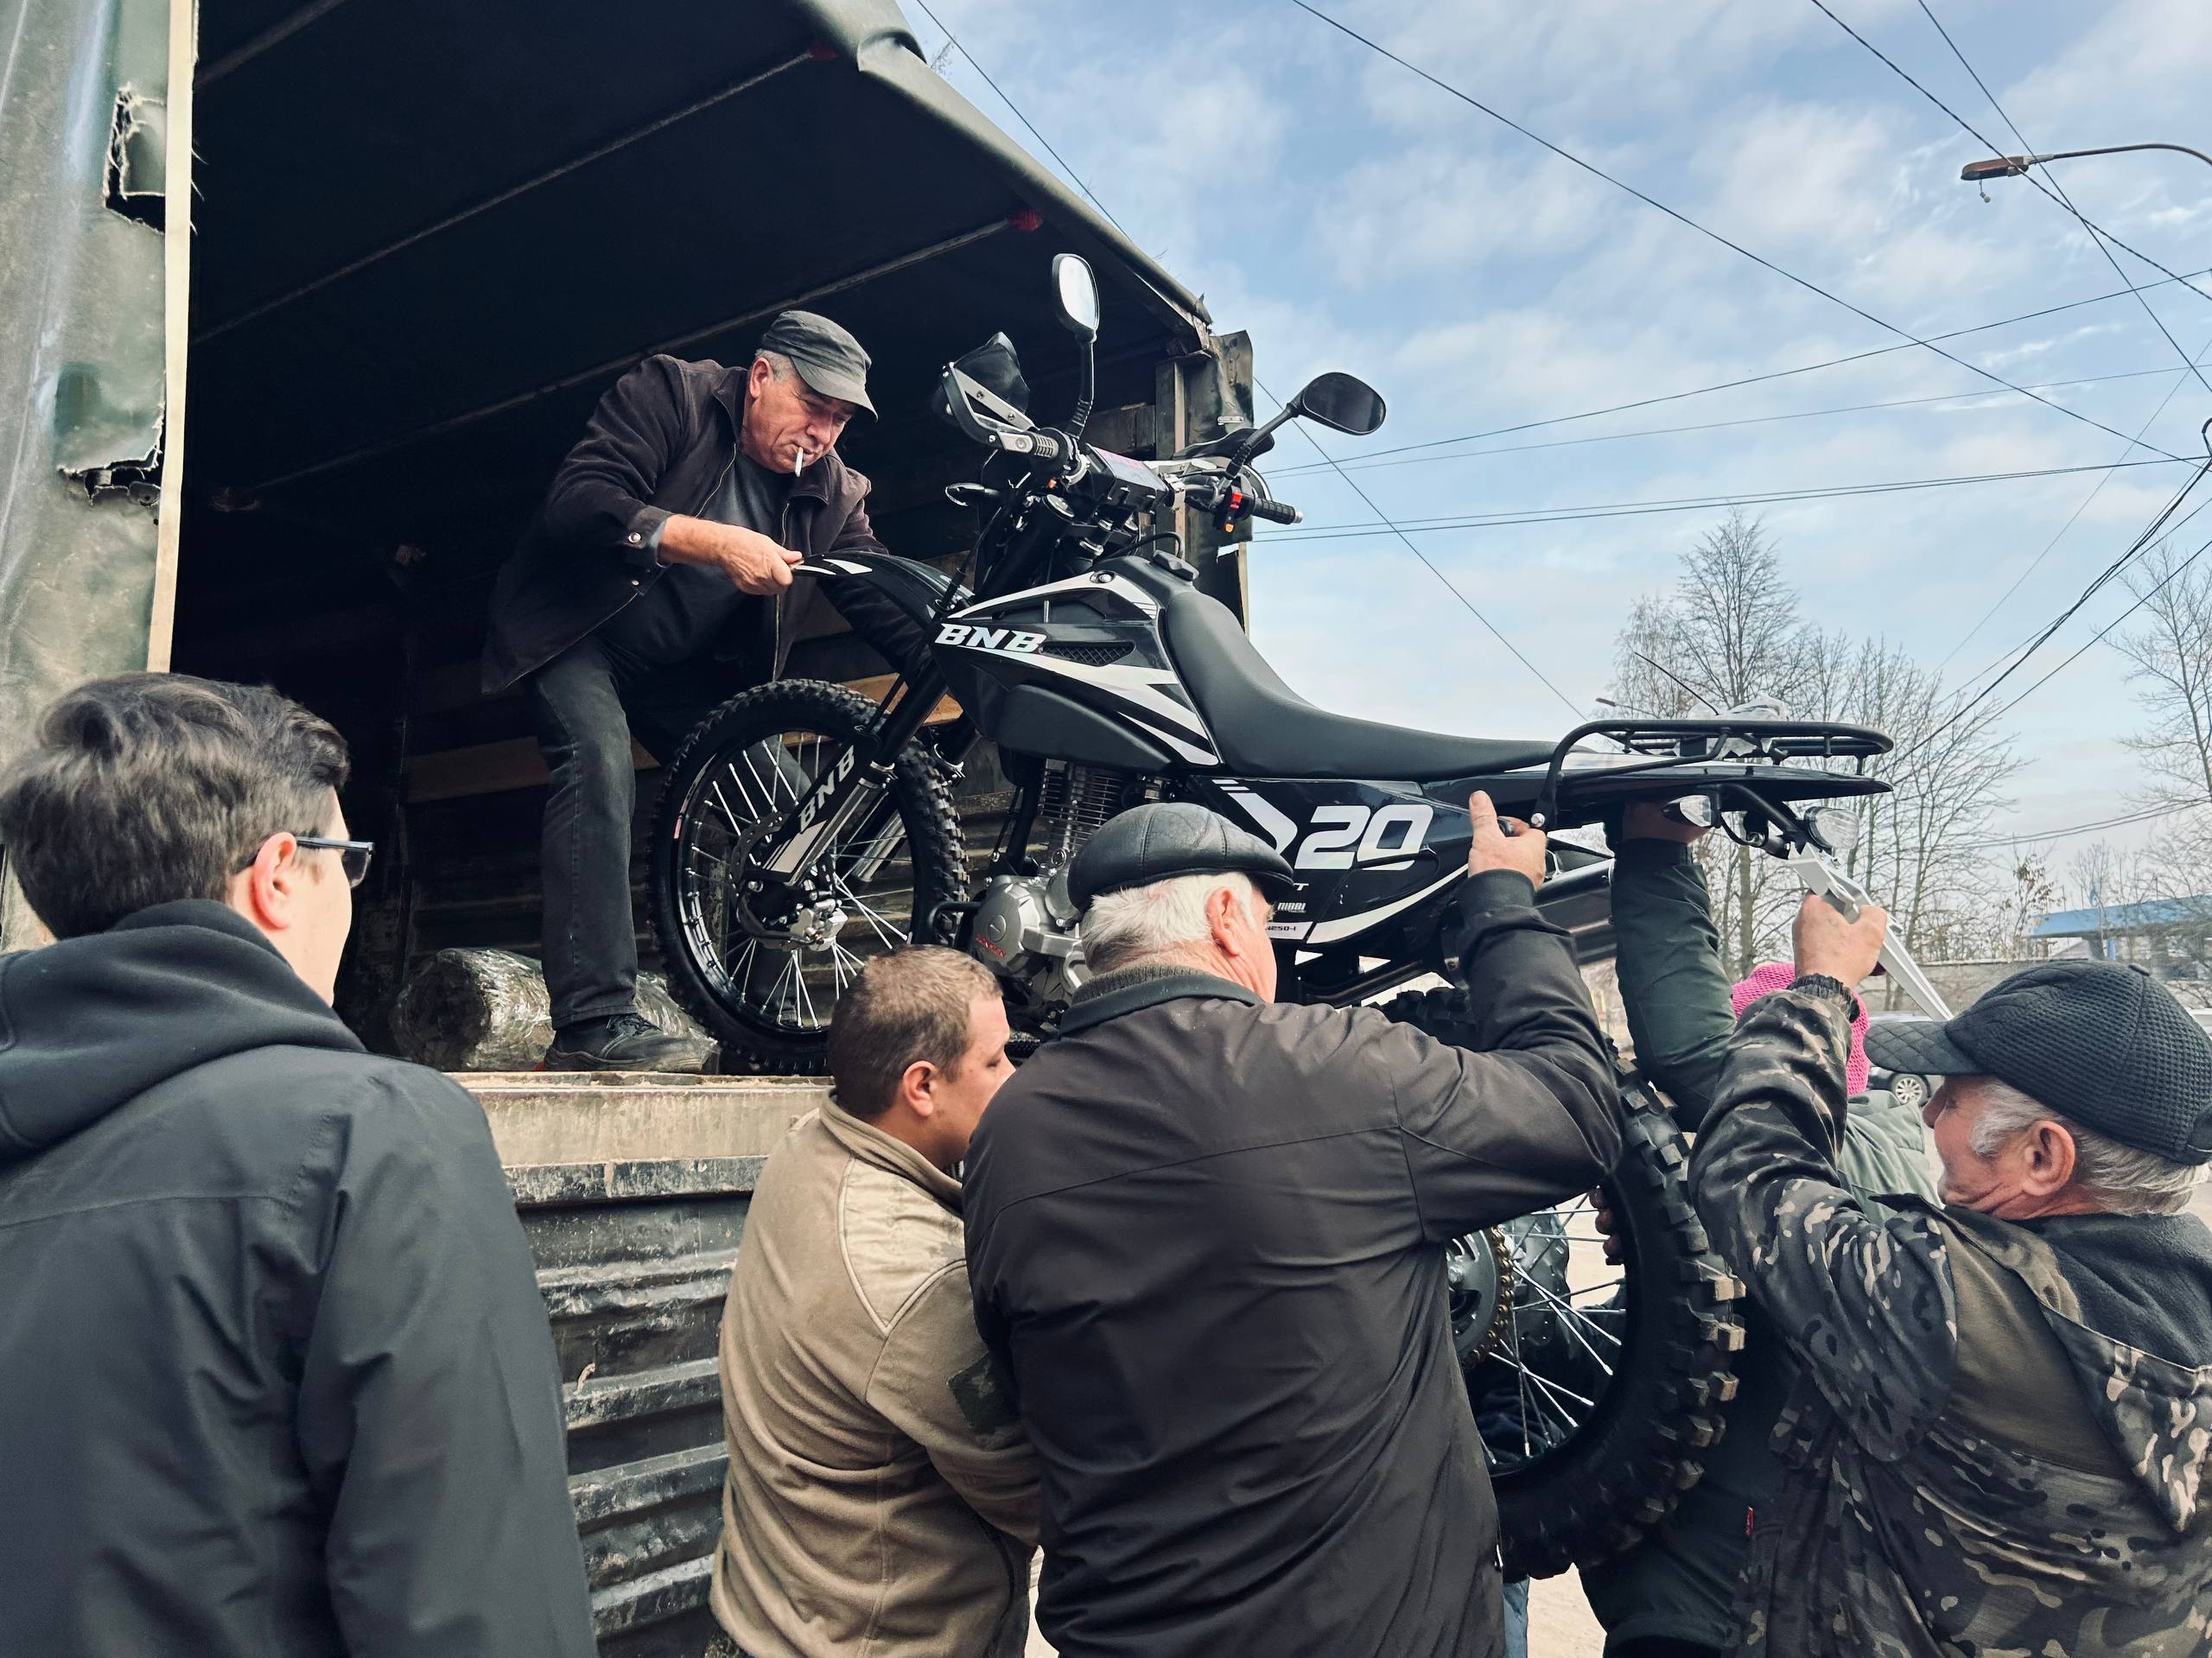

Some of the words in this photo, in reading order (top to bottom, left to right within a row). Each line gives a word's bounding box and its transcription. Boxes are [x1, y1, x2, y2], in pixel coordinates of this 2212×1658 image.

[934, 623, 1047, 652] BNB
[798, 745, 855, 835] BNB
[1294, 804, 1433, 870] 20
